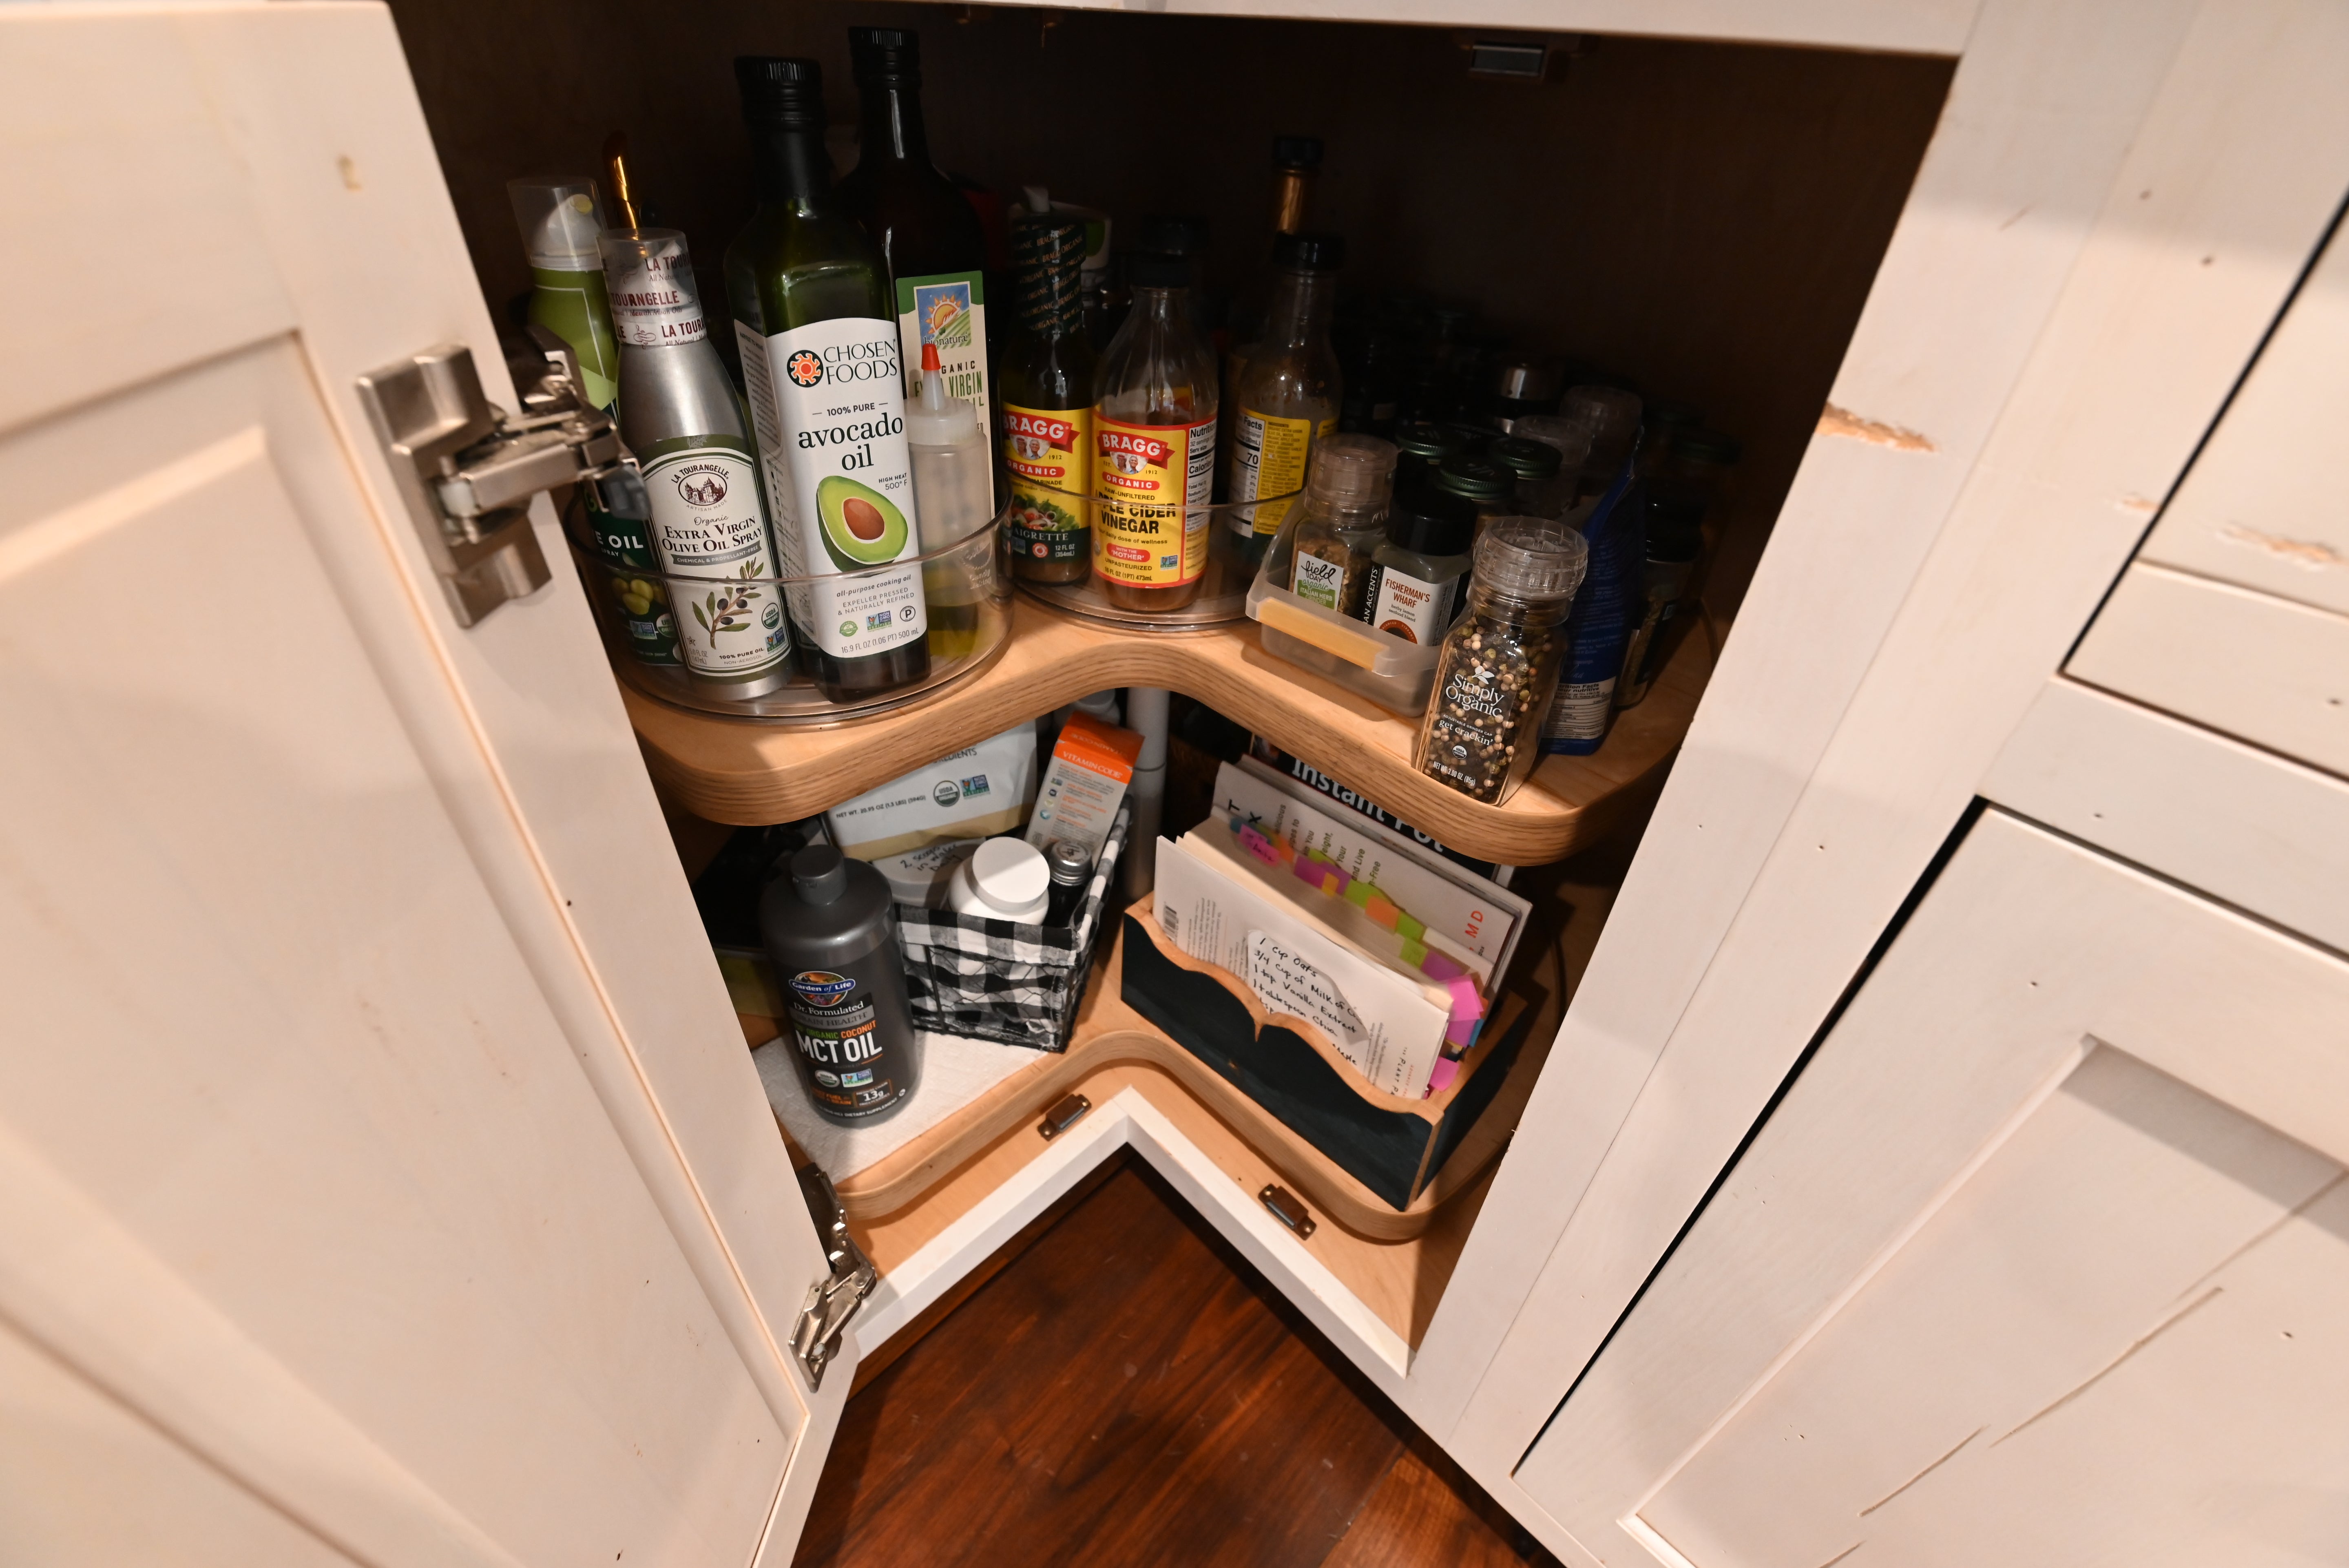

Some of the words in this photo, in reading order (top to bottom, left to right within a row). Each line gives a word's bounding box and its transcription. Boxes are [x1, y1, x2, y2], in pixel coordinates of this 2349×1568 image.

[644, 258, 661, 272] LA
[661, 324, 677, 338] LA
[823, 341, 896, 363] CHOSEN
[825, 357, 897, 385] FOODS
[941, 360, 975, 374] GANIC
[949, 371, 982, 398] VIRGIN
[827, 405, 852, 417] 100%
[853, 402, 876, 413] PURE
[798, 412, 903, 449] avocado
[1002, 414, 1064, 439] BRAGG
[1244, 416, 1262, 430] Facts
[1102, 433, 1161, 456] BRAGG
[841, 443, 874, 471] oil
[1247, 453, 1259, 464] 70
[670, 474, 681, 484] LA
[679, 464, 729, 476] TOURANGELLE
[1007, 460, 1057, 476] ORGANIC
[878, 475, 893, 484] HIGH
[1106, 474, 1152, 489] ORGANIC
[1104, 486, 1155, 500] RAW-UNFILTERED
[713, 499, 728, 510] MADE
[663, 525, 711, 540] EXTRA
[713, 515, 756, 536] VIRGIN
[694, 515, 729, 526] Organic
[1101, 510, 1159, 534] VINEGAR
[608, 535, 644, 550] OIL
[661, 538, 700, 553] OLIVE
[703, 539, 730, 552] OIL
[732, 526, 763, 547] SPRAY
[1105, 532, 1117, 540] daily
[711, 544, 759, 562] PROPELLANT-FREE
[1105, 557, 1152, 571] UNPASTEURIZED
[1301, 560, 1336, 585] field
[1303, 579, 1329, 591] organic
[1309, 573, 1324, 583] DAY
[836, 584, 875, 597] all-purpose
[876, 578, 902, 590] cooking
[1300, 588, 1318, 597] ITALIAN
[1319, 593, 1333, 602] HERB
[1366, 569, 1378, 608] ACCENTS
[1385, 578, 1431, 603] FISHERMAN'S
[843, 595, 877, 608] EXPELLER
[879, 587, 909, 599] PRESSED
[845, 600, 884, 615] NATURALLY
[886, 592, 914, 604] REFINED
[1393, 592, 1418, 608] WHARF
[765, 608, 776, 618] USDA
[1389, 609, 1404, 617] seafood
[1405, 614, 1416, 622] blend
[1403, 608, 1415, 617] lemon
[841, 645, 854, 654] 16.9
[863, 640, 871, 649] OZ
[872, 637, 887, 646] (1.06
[887, 633, 897, 643] PT)
[898, 630, 910, 639] 500
[911, 627, 920, 636] mL
[723, 655, 763, 665] NON-AEROSOL
[1453, 673, 1505, 707] Simply
[1445, 685, 1503, 717] Organic
[1439, 719, 1453, 731] get
[1454, 726, 1494, 746] crackin'
[1443, 714, 1466, 727] ADJUSTABLE
[1466, 724, 1484, 734] GRINDER
[1448, 767, 1457, 778] 3.00
[1464, 775, 1476, 787] (85g)
[1354, 848, 1365, 865] Live
[1254, 950, 1270, 965] 3/4
[1293, 958, 1318, 978] Oats
[792, 982, 822, 992] Garden
[824, 984, 834, 993] of
[835, 982, 852, 990] Life
[794, 1002, 807, 1013] Dr.
[808, 1000, 864, 1016] Formulated
[806, 1028, 839, 1039] ORGANIC
[841, 1020, 876, 1039] COCONUT
[796, 1029, 839, 1064] MCT
[843, 1031, 883, 1062] OIL
[863, 1090, 884, 1102] 13g
